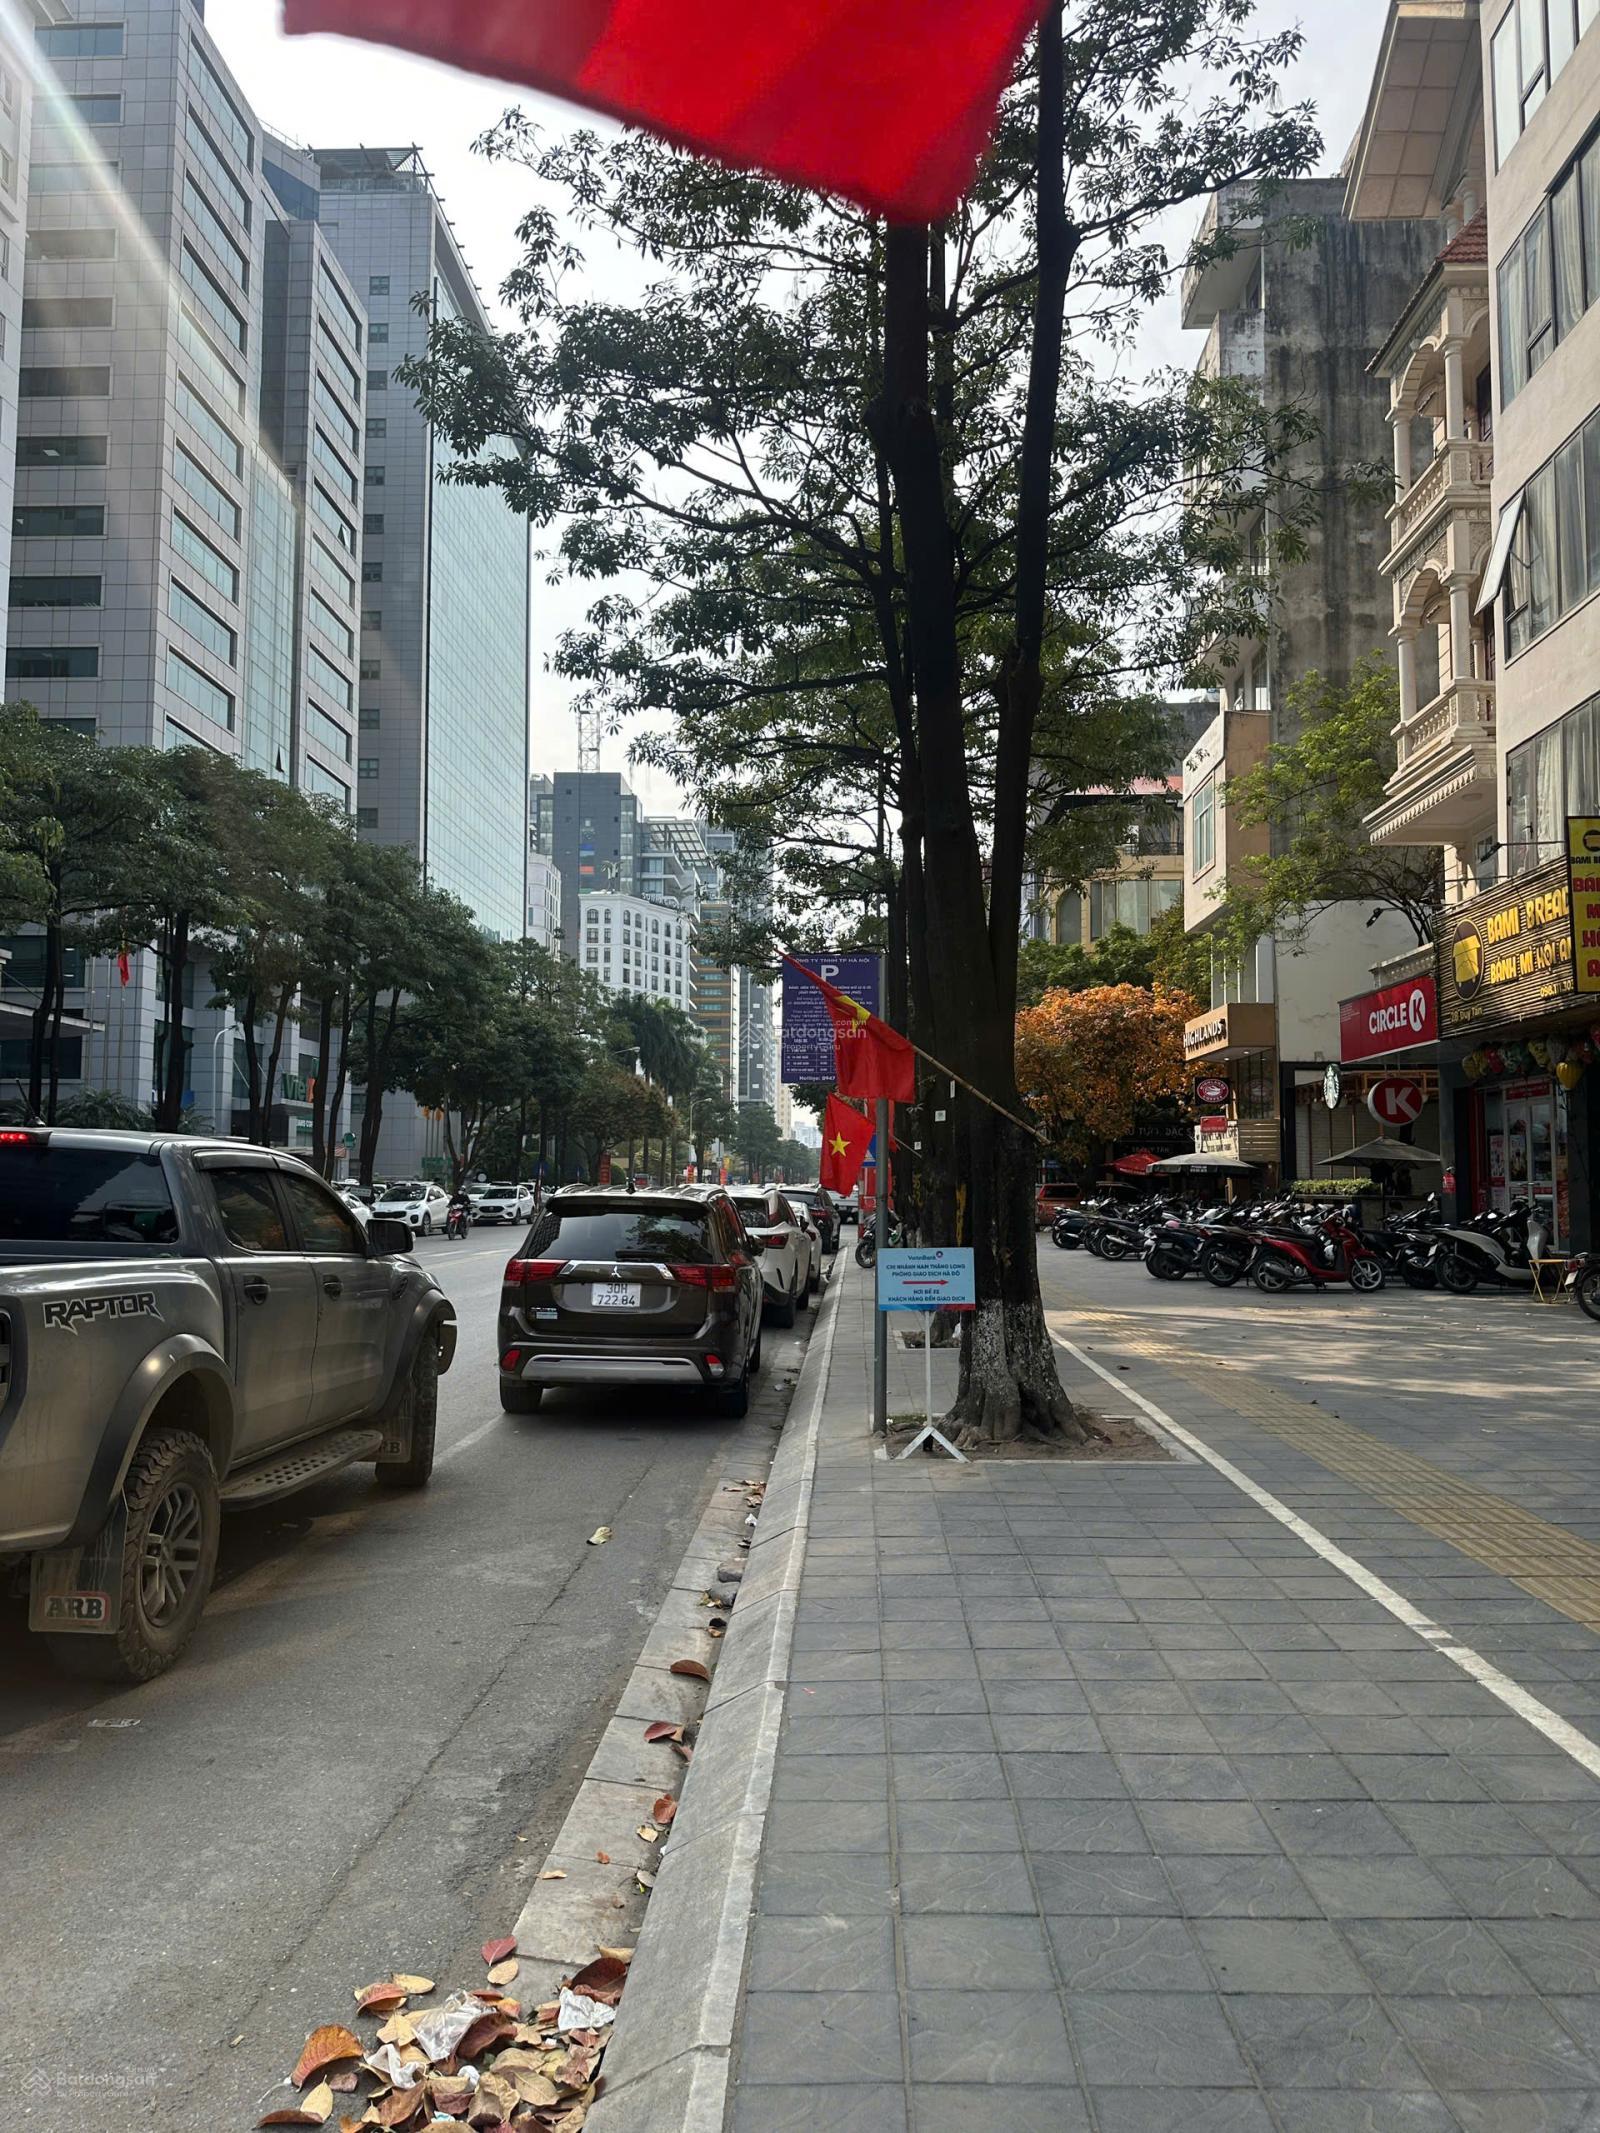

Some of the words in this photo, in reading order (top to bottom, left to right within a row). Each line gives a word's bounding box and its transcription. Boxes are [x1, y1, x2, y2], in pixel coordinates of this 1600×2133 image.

[1487, 907, 1520, 943] BAMI
[821, 965, 839, 982] P
[1490, 955, 1517, 984] BÁNH
[1369, 1002, 1407, 1034] CIRCLE
[1411, 992, 1426, 1031] K
[1183, 1021, 1222, 1048] HIGHLANDS
[1385, 1087, 1419, 1121] K
[606, 1283, 628, 1294] 30H
[42, 1291, 165, 1335] RAPTOR
[46, 1597, 103, 1619] ARB
